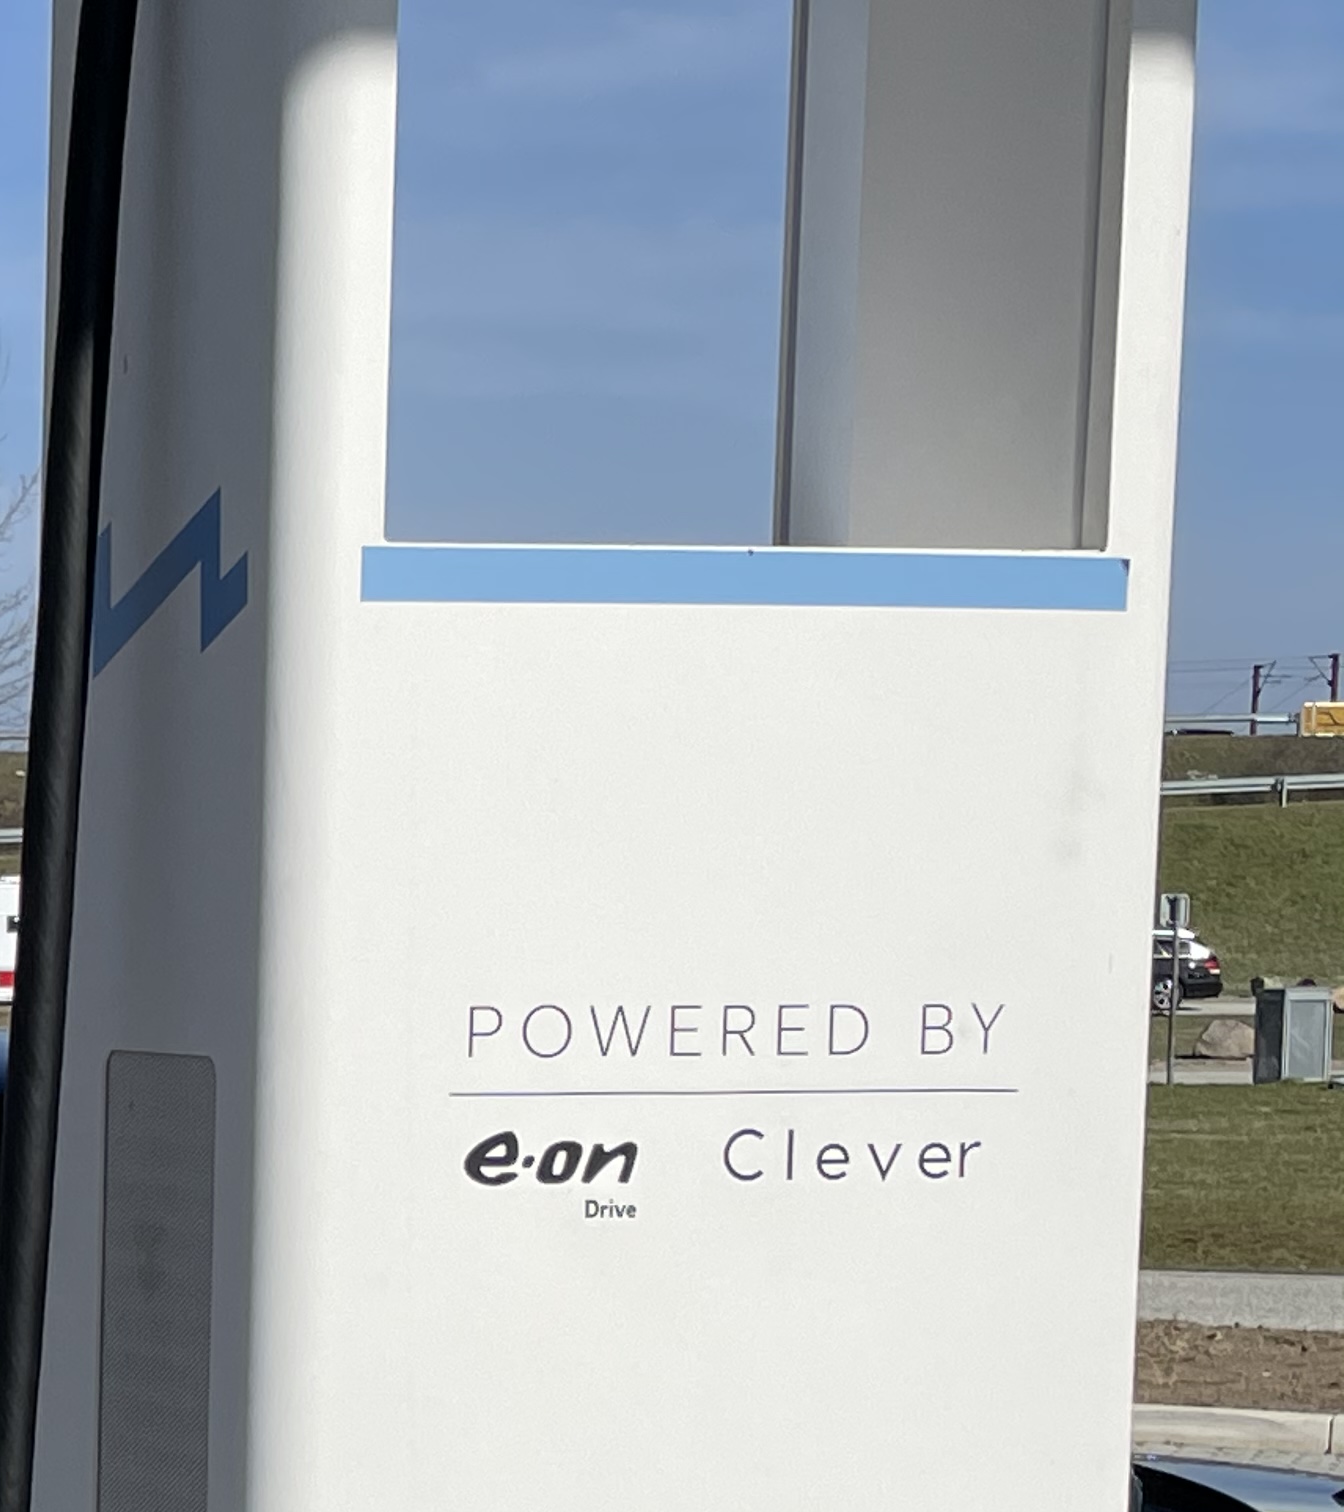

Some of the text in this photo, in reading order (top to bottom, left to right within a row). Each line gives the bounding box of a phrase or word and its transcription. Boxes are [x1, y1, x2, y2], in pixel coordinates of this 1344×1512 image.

[467, 1002, 1005, 1058] POWERED BY
[722, 1128, 982, 1181] Clever
[583, 1200, 638, 1219] Drive
